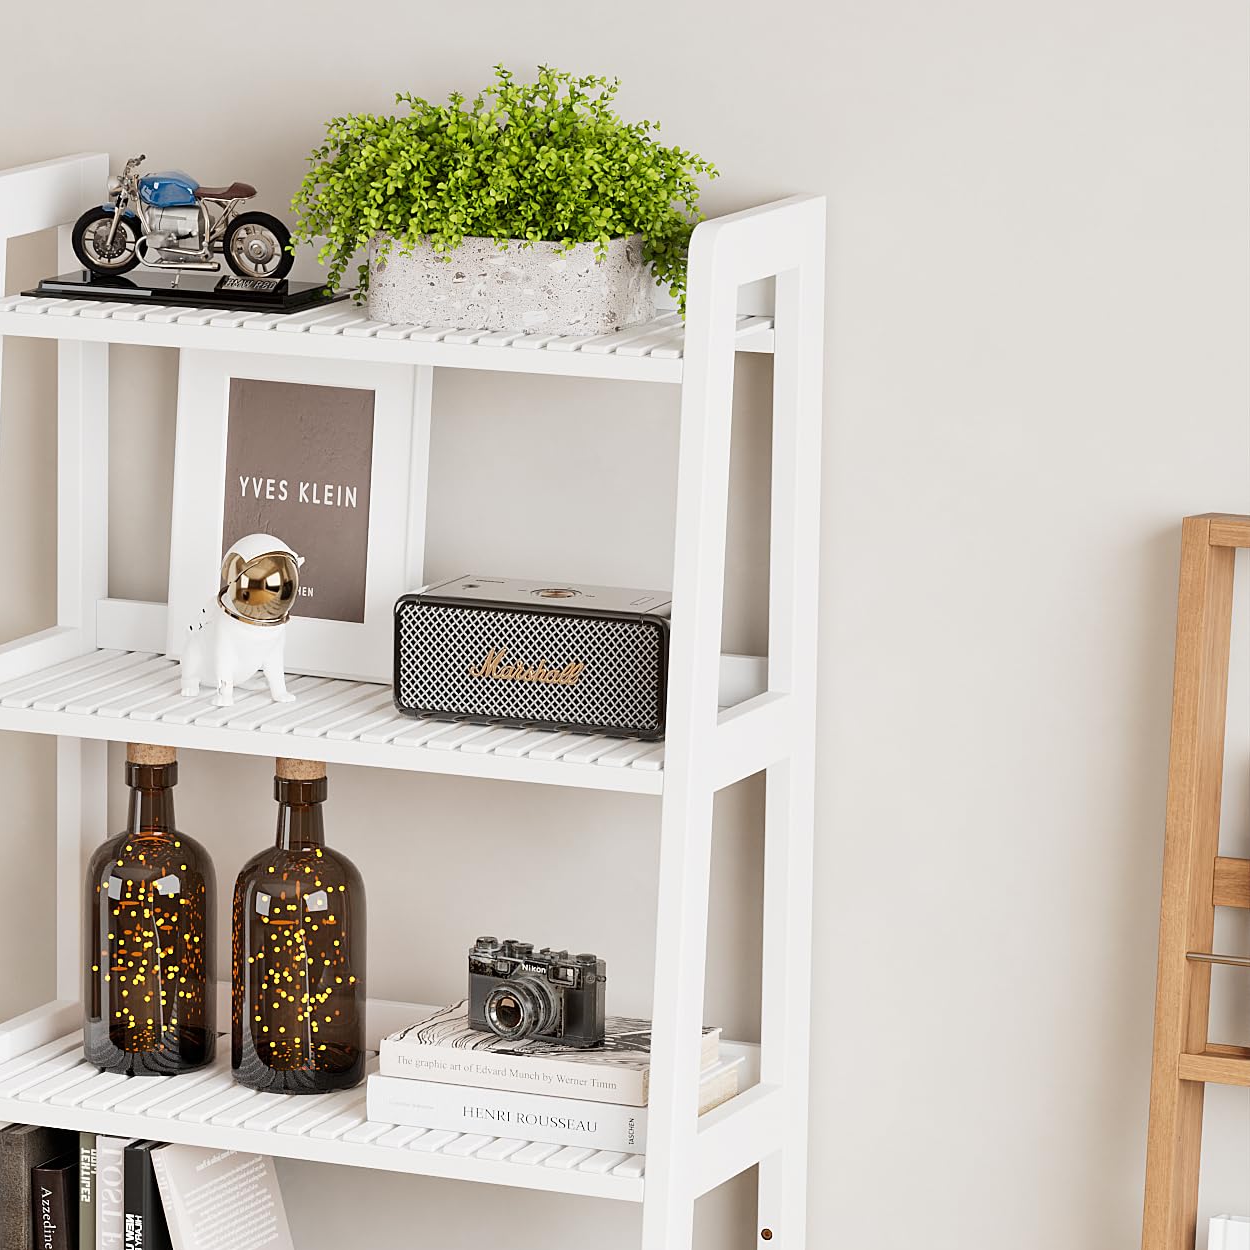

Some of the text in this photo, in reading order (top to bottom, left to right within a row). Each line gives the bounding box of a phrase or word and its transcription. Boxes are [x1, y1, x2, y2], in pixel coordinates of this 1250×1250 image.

[239, 475, 357, 508] YVES KLEIN
[468, 645, 587, 686] Marshall
[521, 963, 547, 974] Nikon
[398, 1055, 618, 1090] The graphic art of Edvard Munch by Werner Timm
[463, 1105, 598, 1133] HENRI ROUSSEAU
[40, 1186, 57, 1250] Azzedine
